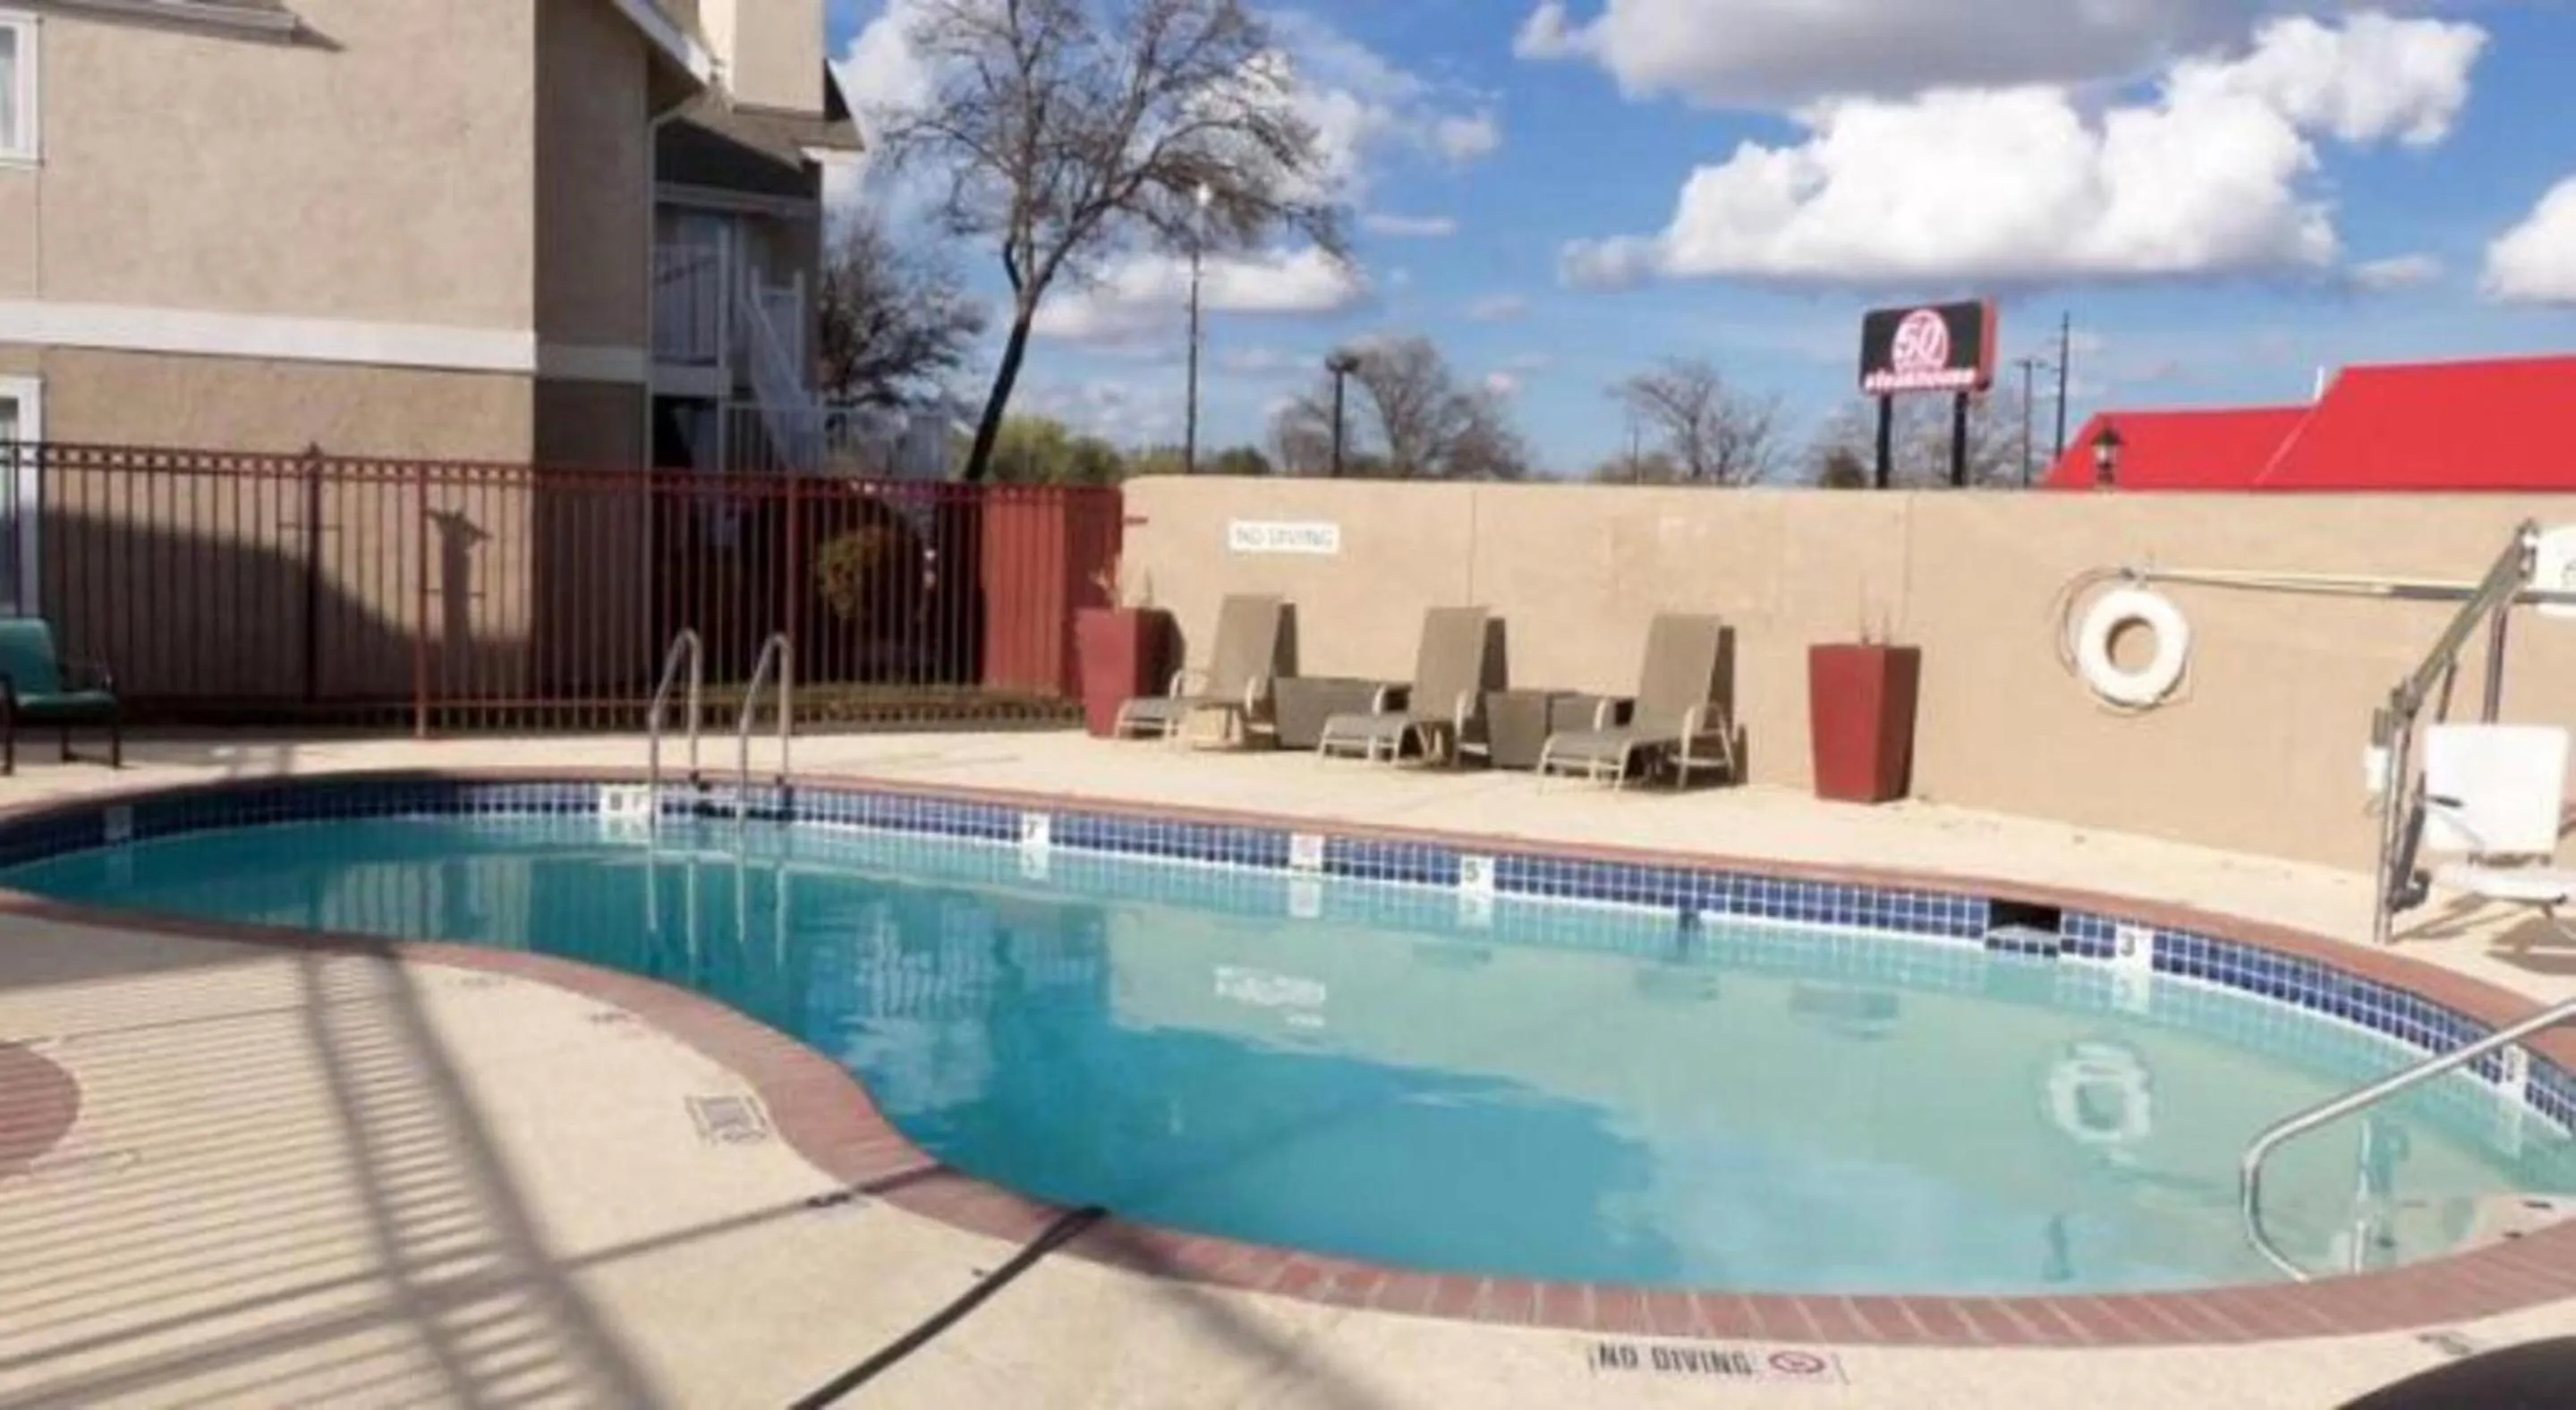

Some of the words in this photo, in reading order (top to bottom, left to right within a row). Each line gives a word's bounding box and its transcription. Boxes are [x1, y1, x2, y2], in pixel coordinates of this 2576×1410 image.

[1237, 526, 1265, 545] NO
[1465, 861, 1479, 882] 5
[2121, 932, 2135, 956] 3
[1599, 1342, 1638, 1369] NO
[1651, 1346, 1753, 1376] DIVING
